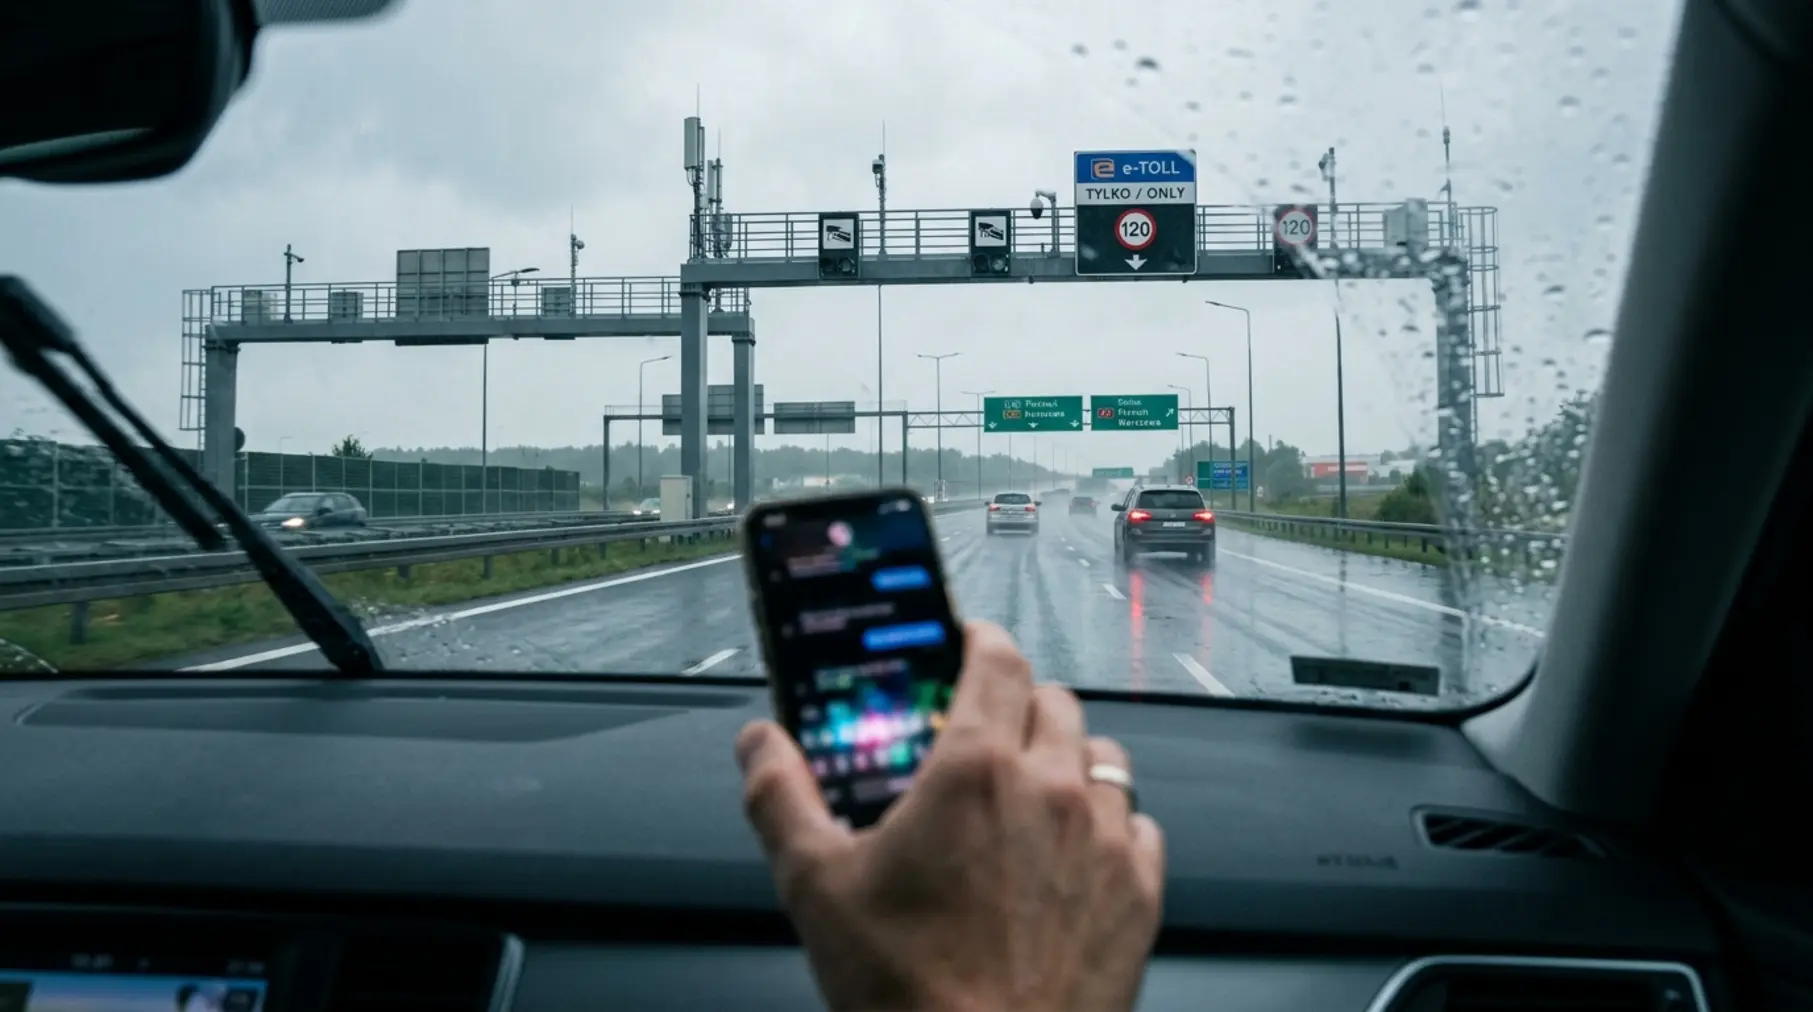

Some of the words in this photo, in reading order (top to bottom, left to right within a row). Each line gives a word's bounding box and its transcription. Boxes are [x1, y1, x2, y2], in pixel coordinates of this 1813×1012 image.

[1122, 161, 1180, 175] e-TOLL
[1086, 188, 1131, 200] TYLKO
[1136, 188, 1142, 200] /
[1147, 187, 1185, 199] ONLY
[1121, 221, 1150, 237] 120
[1283, 219, 1310, 235] 120
